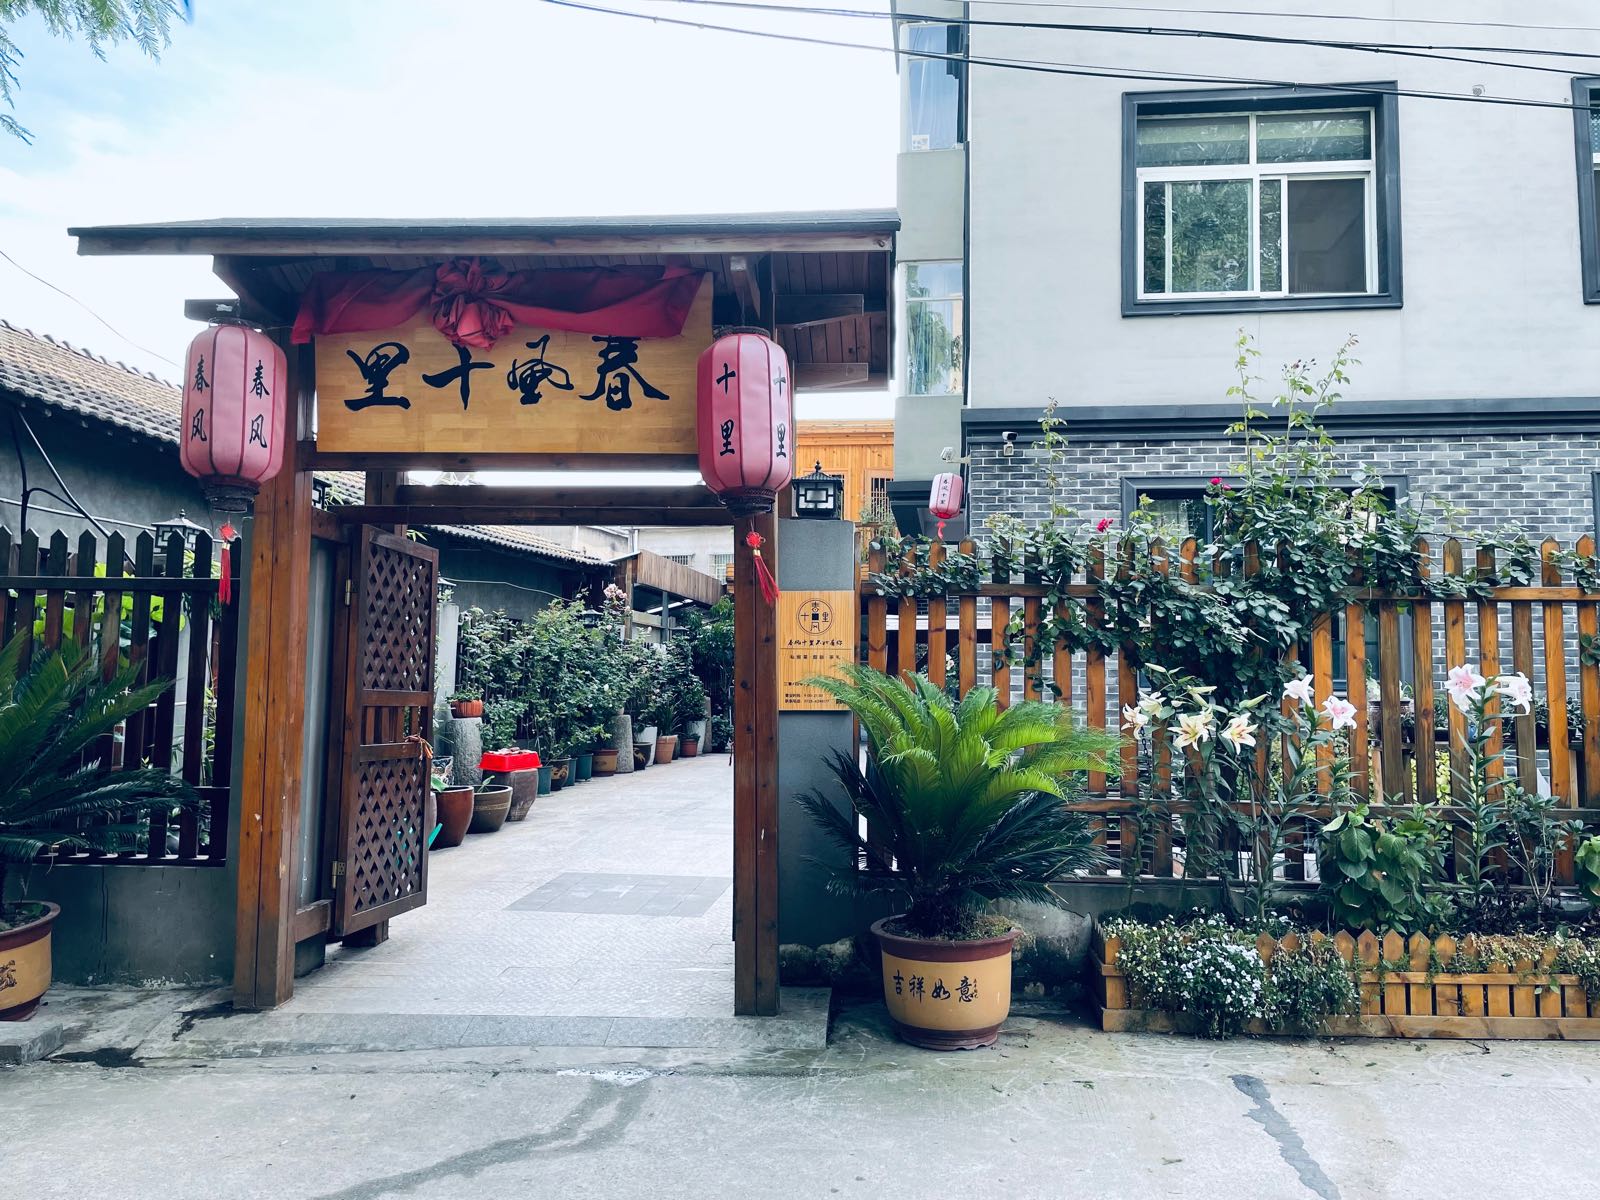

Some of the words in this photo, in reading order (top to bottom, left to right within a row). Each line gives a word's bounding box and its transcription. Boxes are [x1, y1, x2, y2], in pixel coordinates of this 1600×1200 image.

[190, 354, 210, 442] 春风
[249, 359, 270, 448] 春风
[716, 362, 736, 457] 十里
[773, 366, 787, 458] 十里
[892, 969, 973, 1003] 吉祥如意
